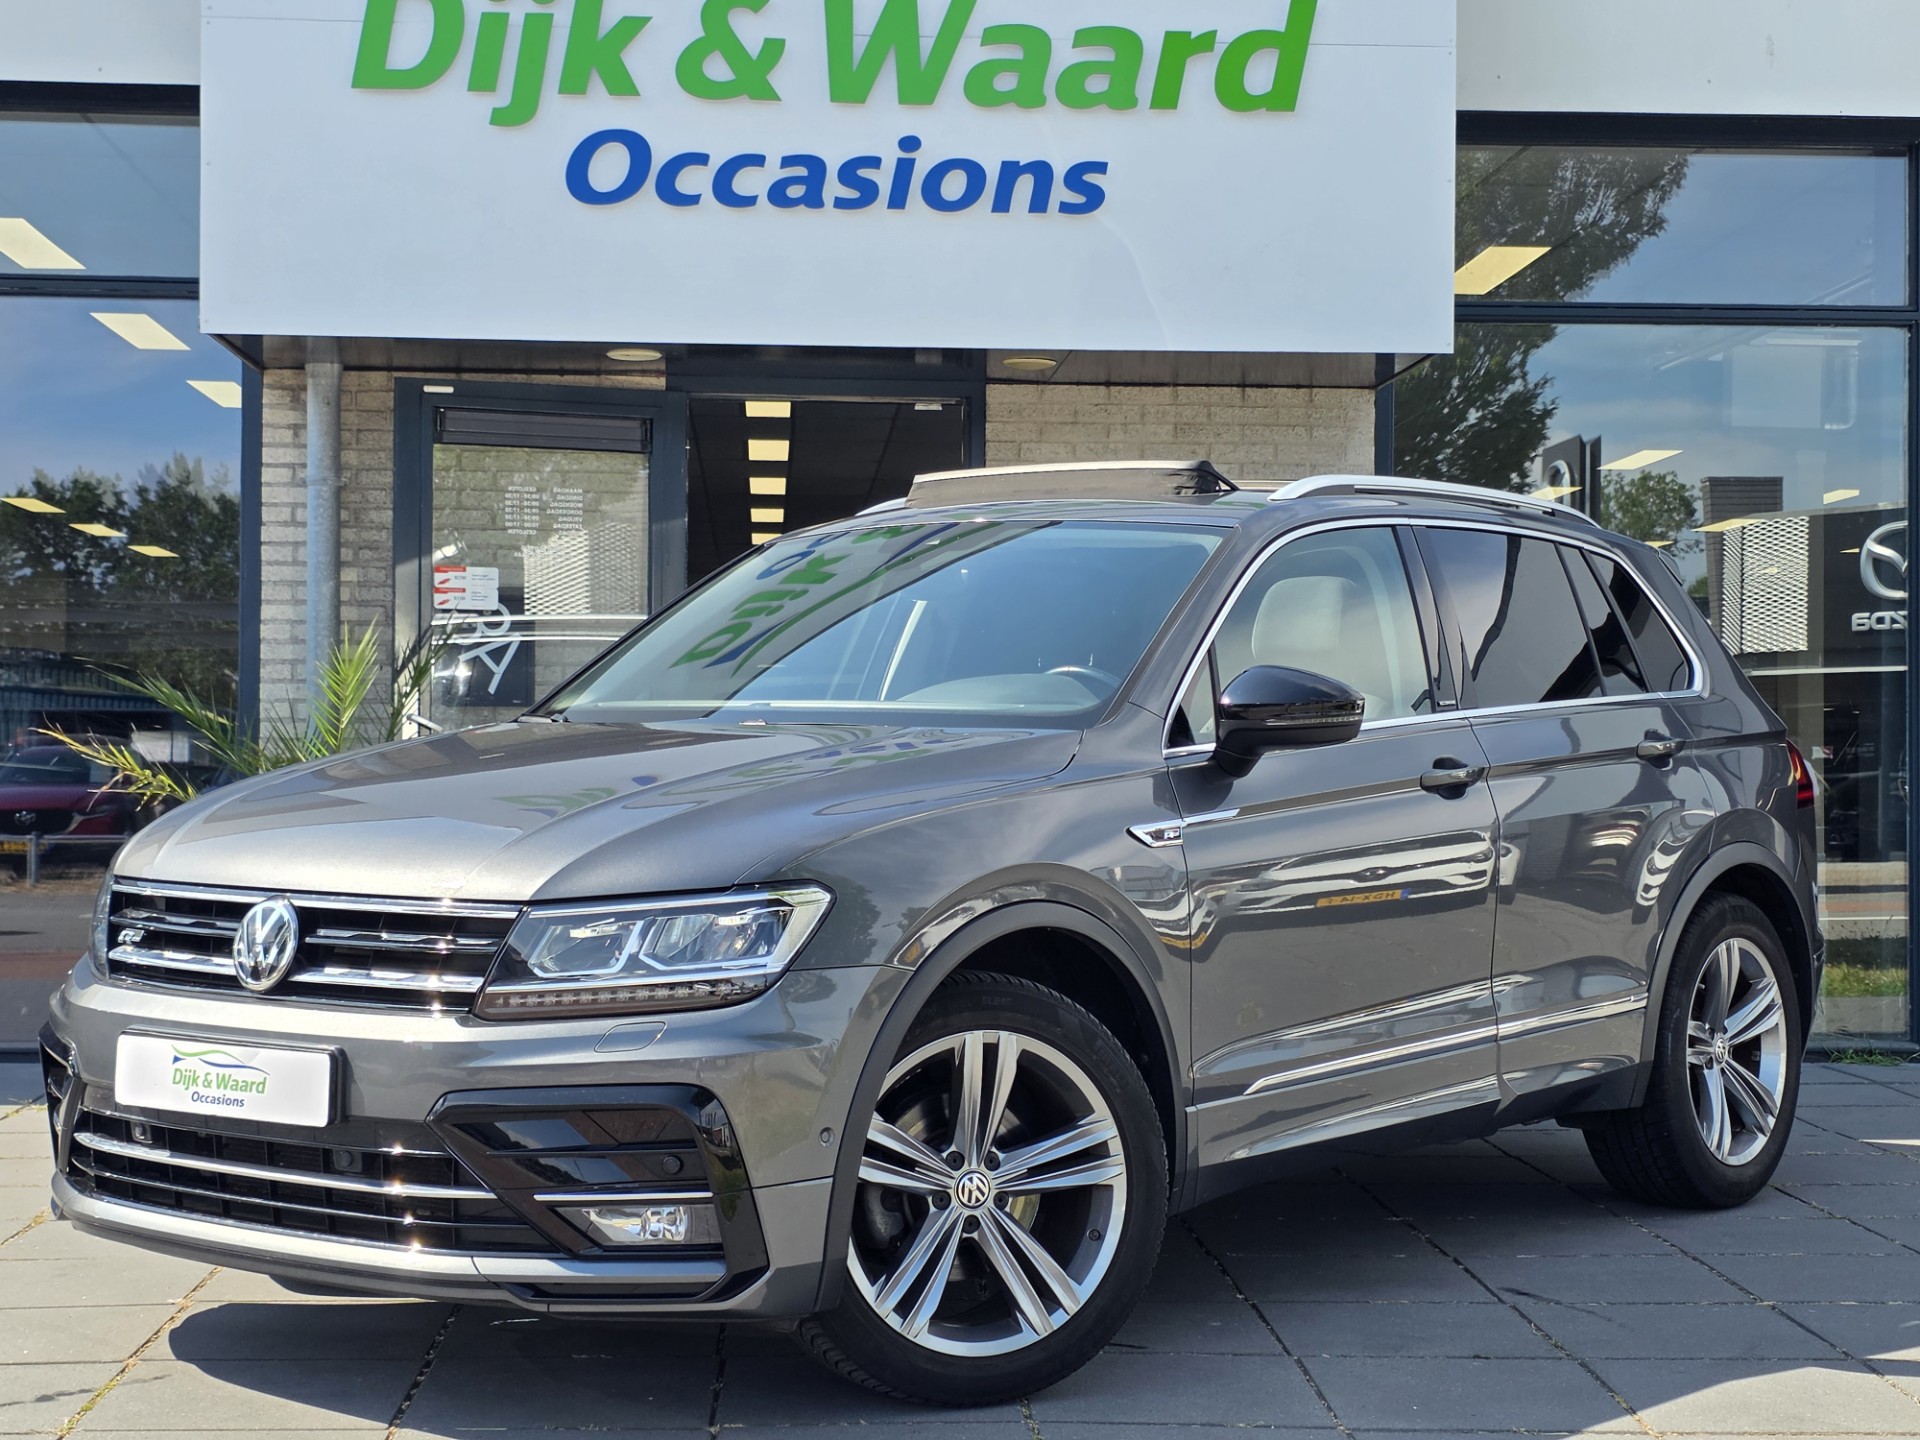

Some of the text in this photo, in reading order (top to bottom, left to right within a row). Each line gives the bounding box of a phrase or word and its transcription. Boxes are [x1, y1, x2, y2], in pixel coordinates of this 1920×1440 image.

[351, 0, 1318, 127] Dijk & Waard
[565, 129, 1109, 215] Occasions
[172, 1068, 267, 1094] Dijk & Waard
[191, 1091, 245, 1107] Occasions
